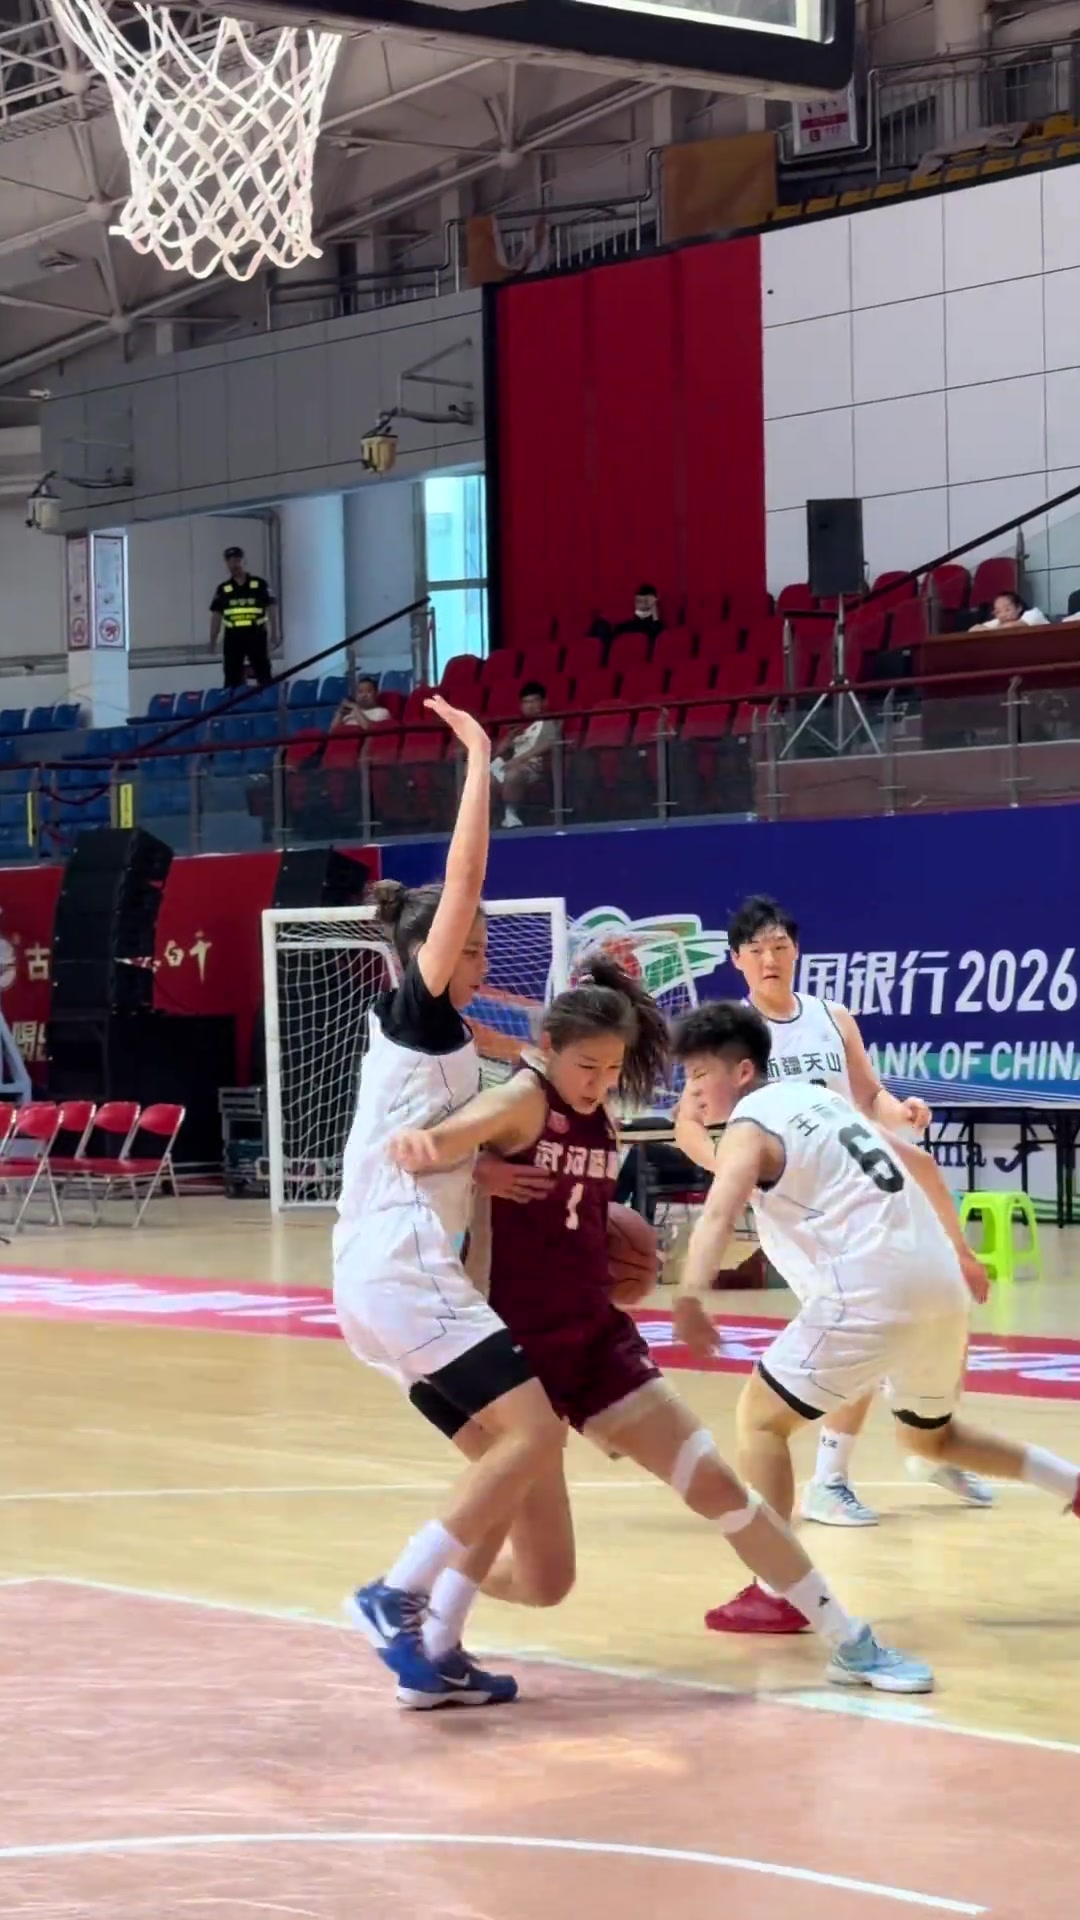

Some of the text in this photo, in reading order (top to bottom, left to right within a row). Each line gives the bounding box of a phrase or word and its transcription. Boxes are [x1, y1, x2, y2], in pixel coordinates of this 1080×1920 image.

[791, 947, 1078, 1016] 国银行2026
[939, 1041, 983, 1081] OF
[990, 1041, 1080, 1081] CHIN
[838, 1122, 905, 1193] 6
[565, 1182, 584, 1231] 1
